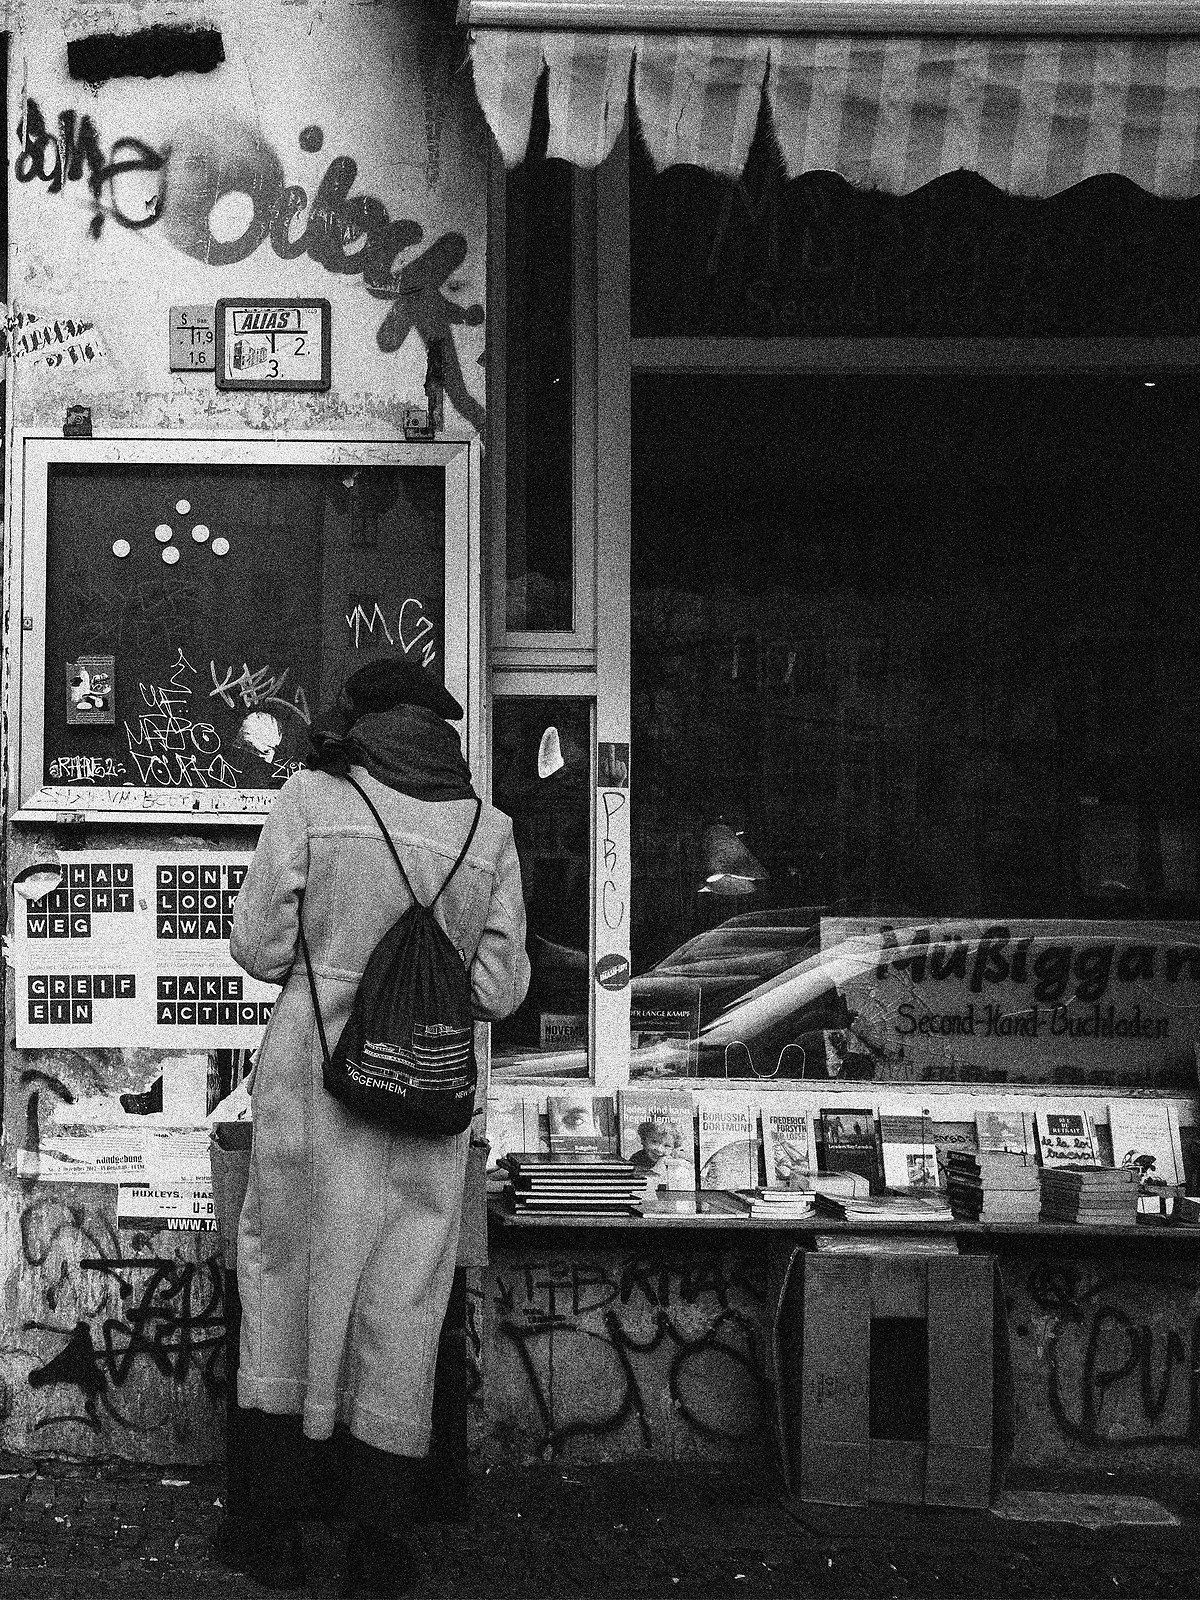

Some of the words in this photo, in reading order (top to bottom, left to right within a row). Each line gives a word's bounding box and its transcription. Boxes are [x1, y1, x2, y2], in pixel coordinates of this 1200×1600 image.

[241, 312, 290, 330] ALIAS
[28, 919, 89, 933] WEG
[31, 979, 131, 993] GREIF
[162, 981, 238, 995] TAKE
[34, 1005, 89, 1019] EIN
[161, 1007, 272, 1020] ACTION
[702, 1112, 747, 1122] BORUSSIA
[769, 1116, 806, 1124] FREDERICK
[702, 1122, 754, 1133] DORTMUND
[776, 1124, 807, 1132] FORSYTH
